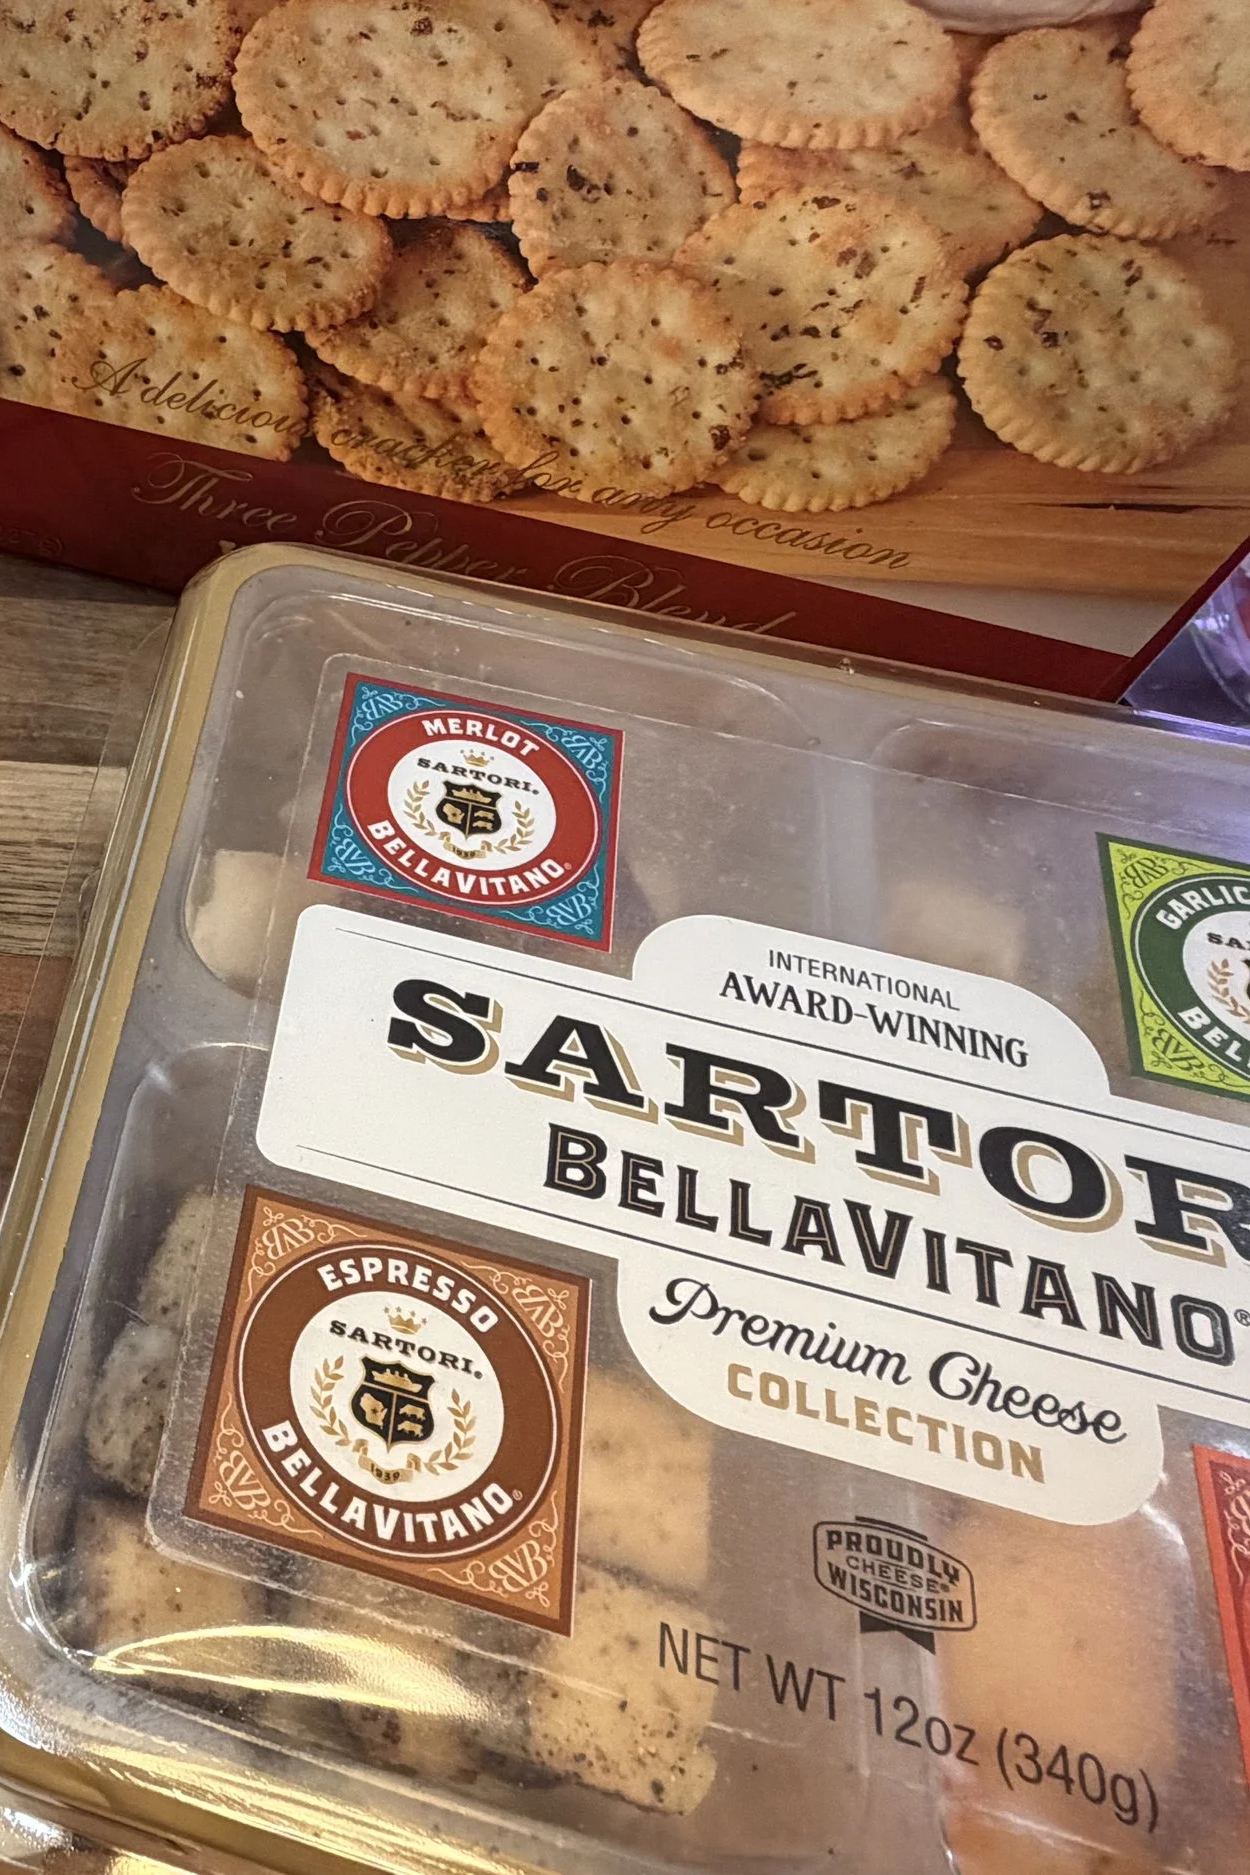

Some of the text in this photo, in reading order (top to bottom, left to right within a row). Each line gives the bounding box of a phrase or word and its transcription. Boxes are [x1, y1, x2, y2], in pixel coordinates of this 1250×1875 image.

[132, 452, 297, 532] Three
[592, 486, 700, 534] any
[706, 511, 910, 570] occasion
[421, 717, 540, 758] MERLOT
[719, 971, 1030, 1068] AWARD-WINNING
[768, 948, 961, 1012] INTERNATIONAL
[317, 1256, 499, 1334] ESPRESSO
[649, 1276, 1128, 1445] Premium Cheese
[727, 1362, 1047, 1484] COLLECTION
[825, 1529, 961, 1587] PROUDLY
[827, 1561, 964, 1623] WISCONSIN
[657, 1620, 1160, 1835] NET WT 12oz (340g)
